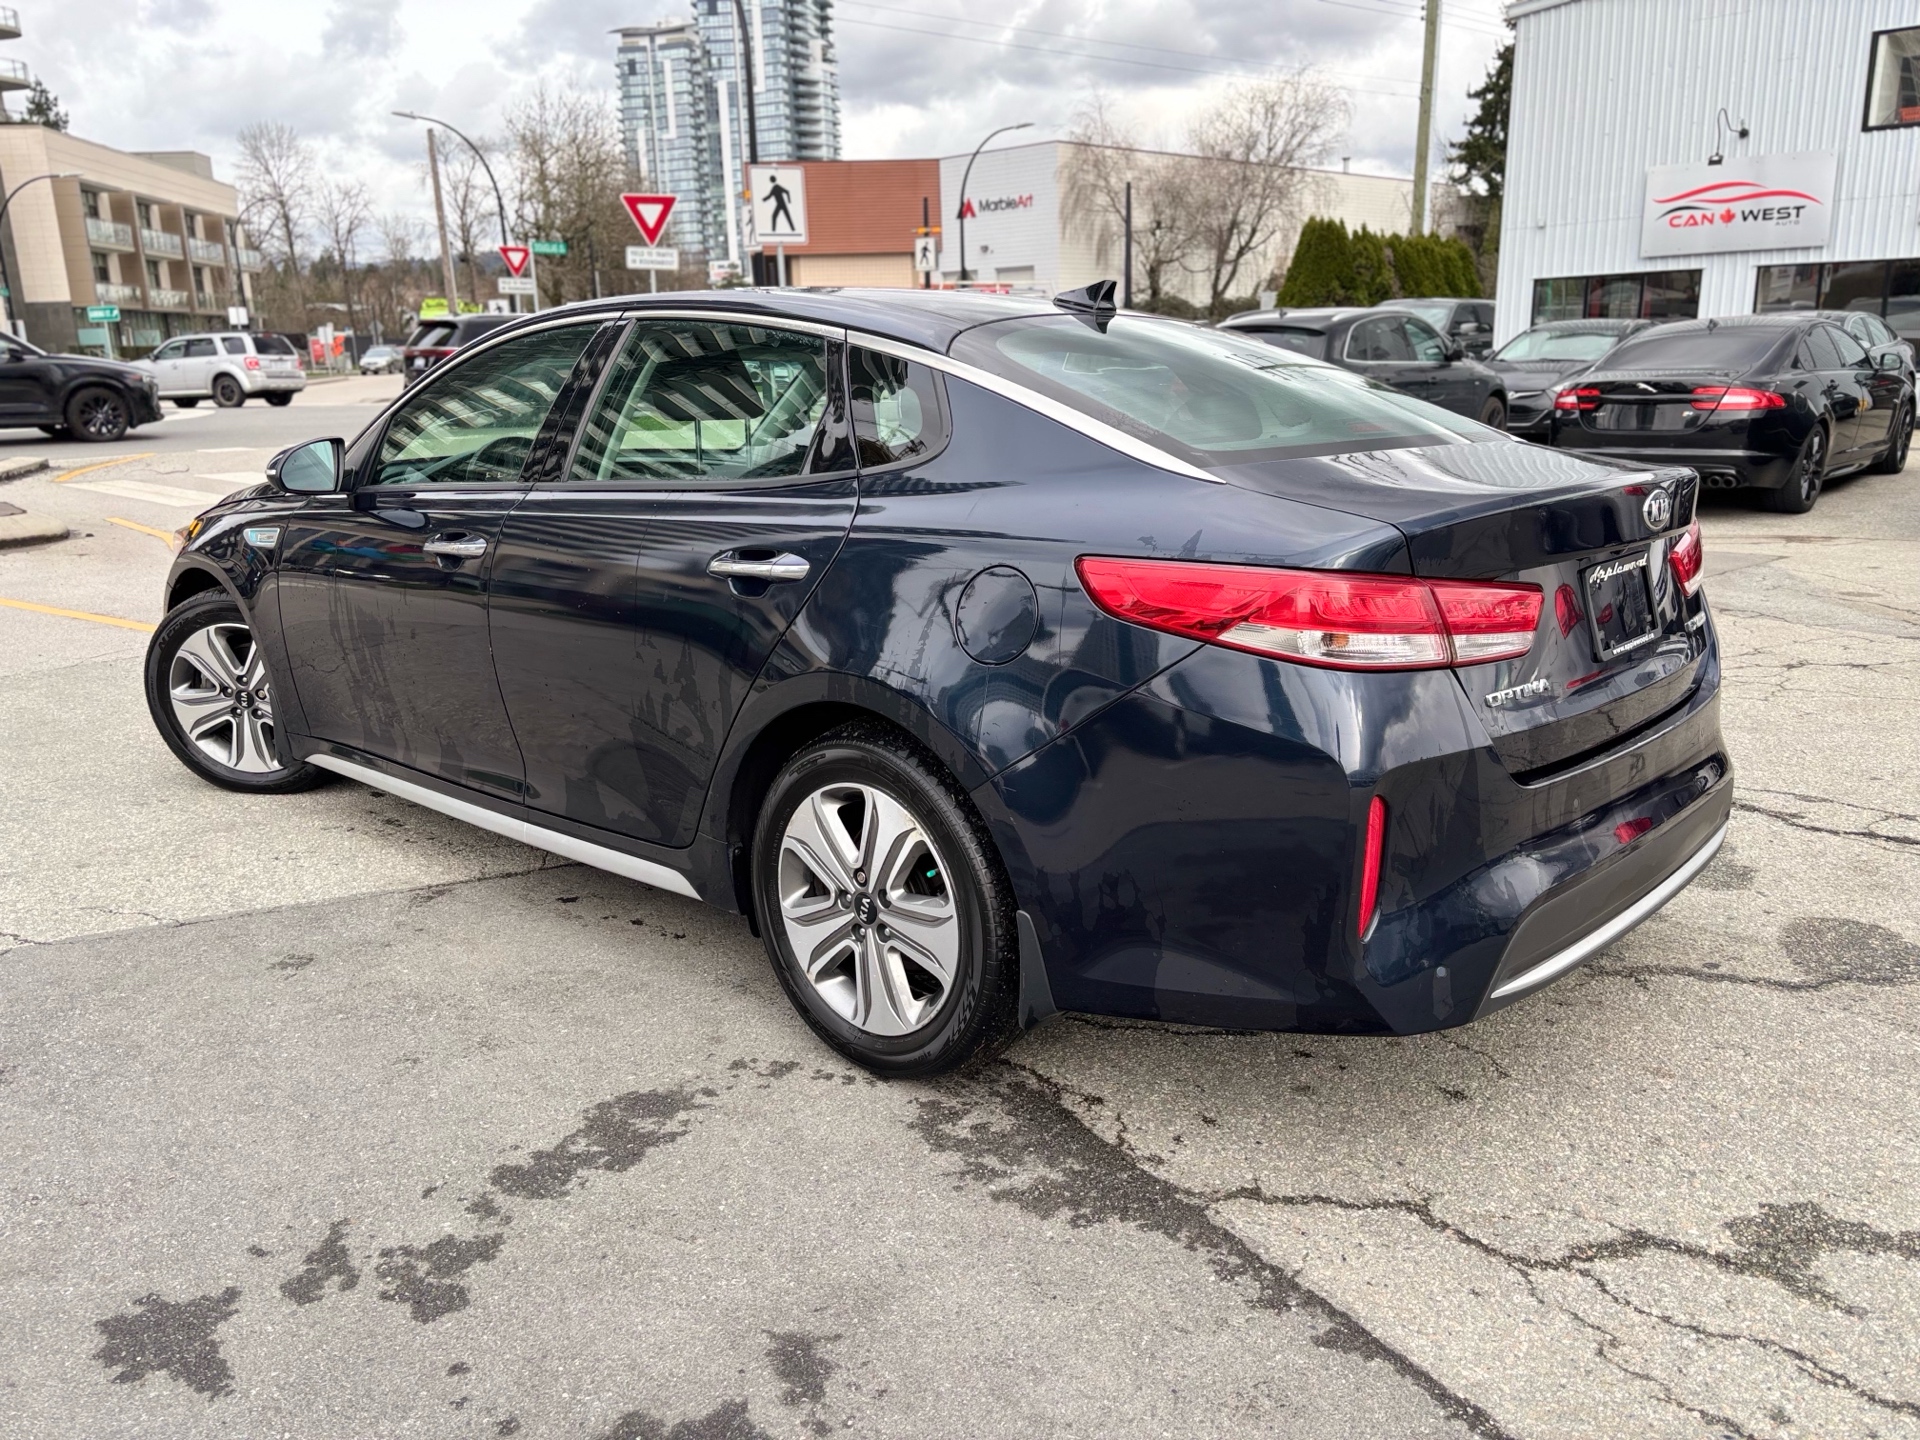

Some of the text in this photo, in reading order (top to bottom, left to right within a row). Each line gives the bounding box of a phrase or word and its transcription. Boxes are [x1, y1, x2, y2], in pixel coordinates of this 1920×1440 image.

[978, 193, 1034, 213] MarbleArt
[1668, 205, 1806, 229] CAN WEST
[1774, 219, 1800, 227] AUTO
[1589, 553, 1648, 584] Applewood
[240, 691, 249, 707] KIA
[1485, 678, 1551, 708] OPTIMA
[859, 897, 871, 922] KIA
